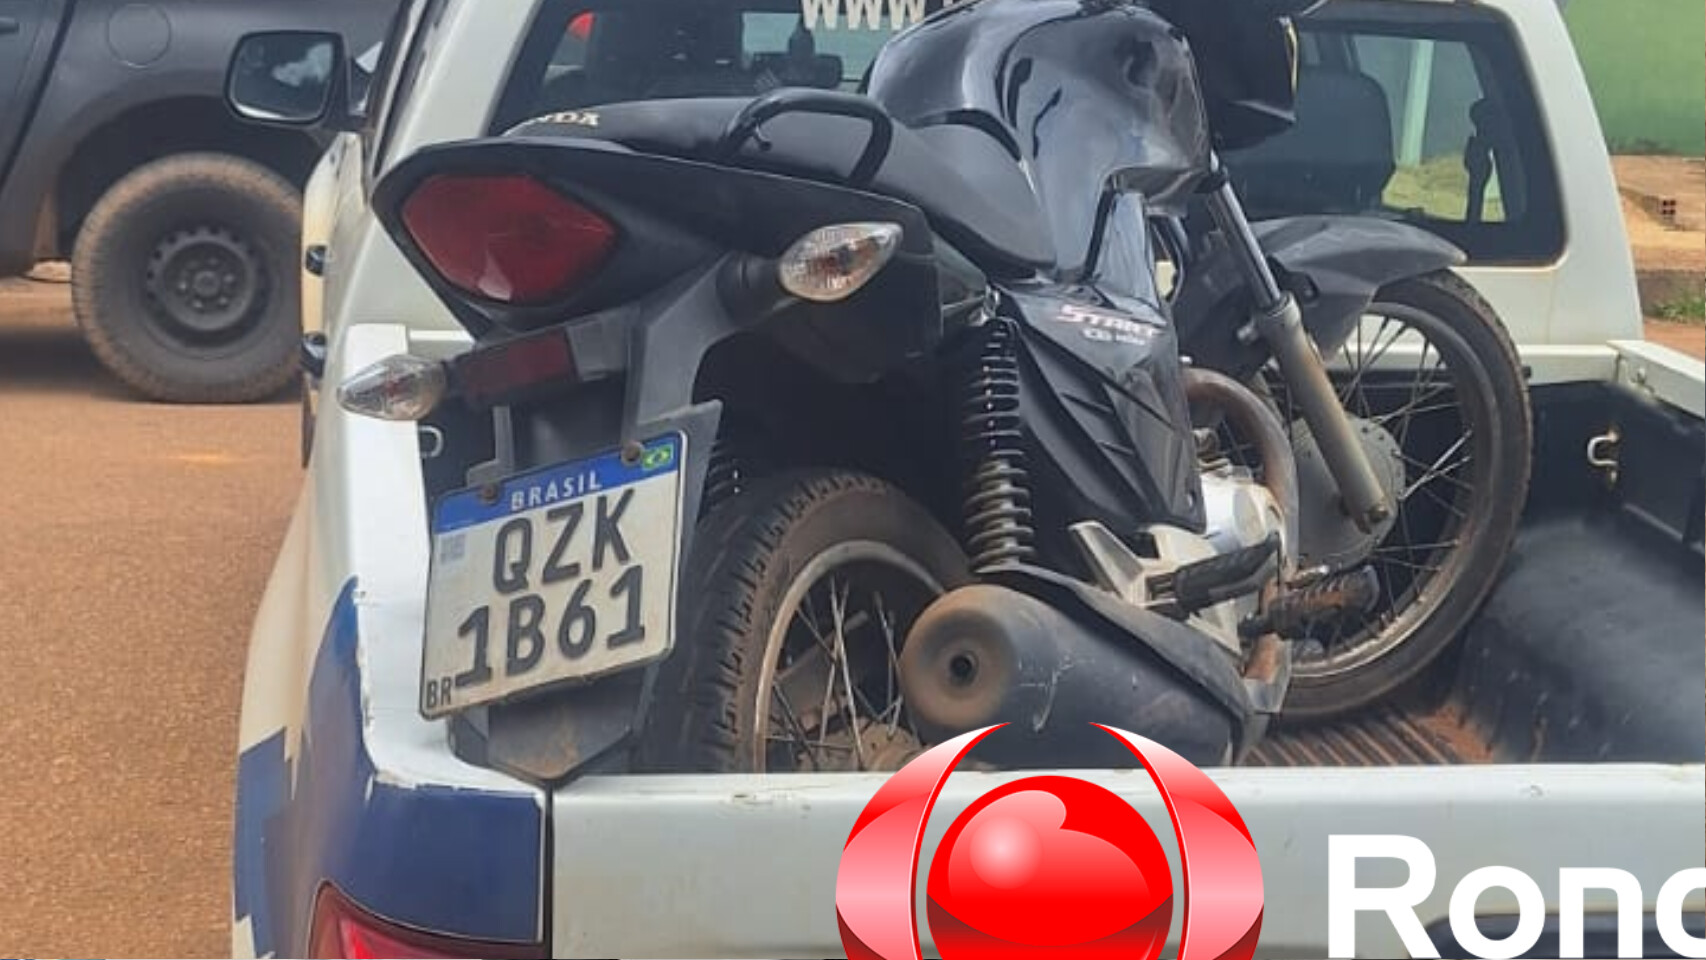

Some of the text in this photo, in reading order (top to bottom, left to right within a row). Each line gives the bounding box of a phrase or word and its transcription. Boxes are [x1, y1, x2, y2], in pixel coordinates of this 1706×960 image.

[511, 469, 602, 511] BRASIL
[493, 487, 635, 595] QZK
[455, 563, 646, 689] 1B61
[425, 675, 453, 709] BR
